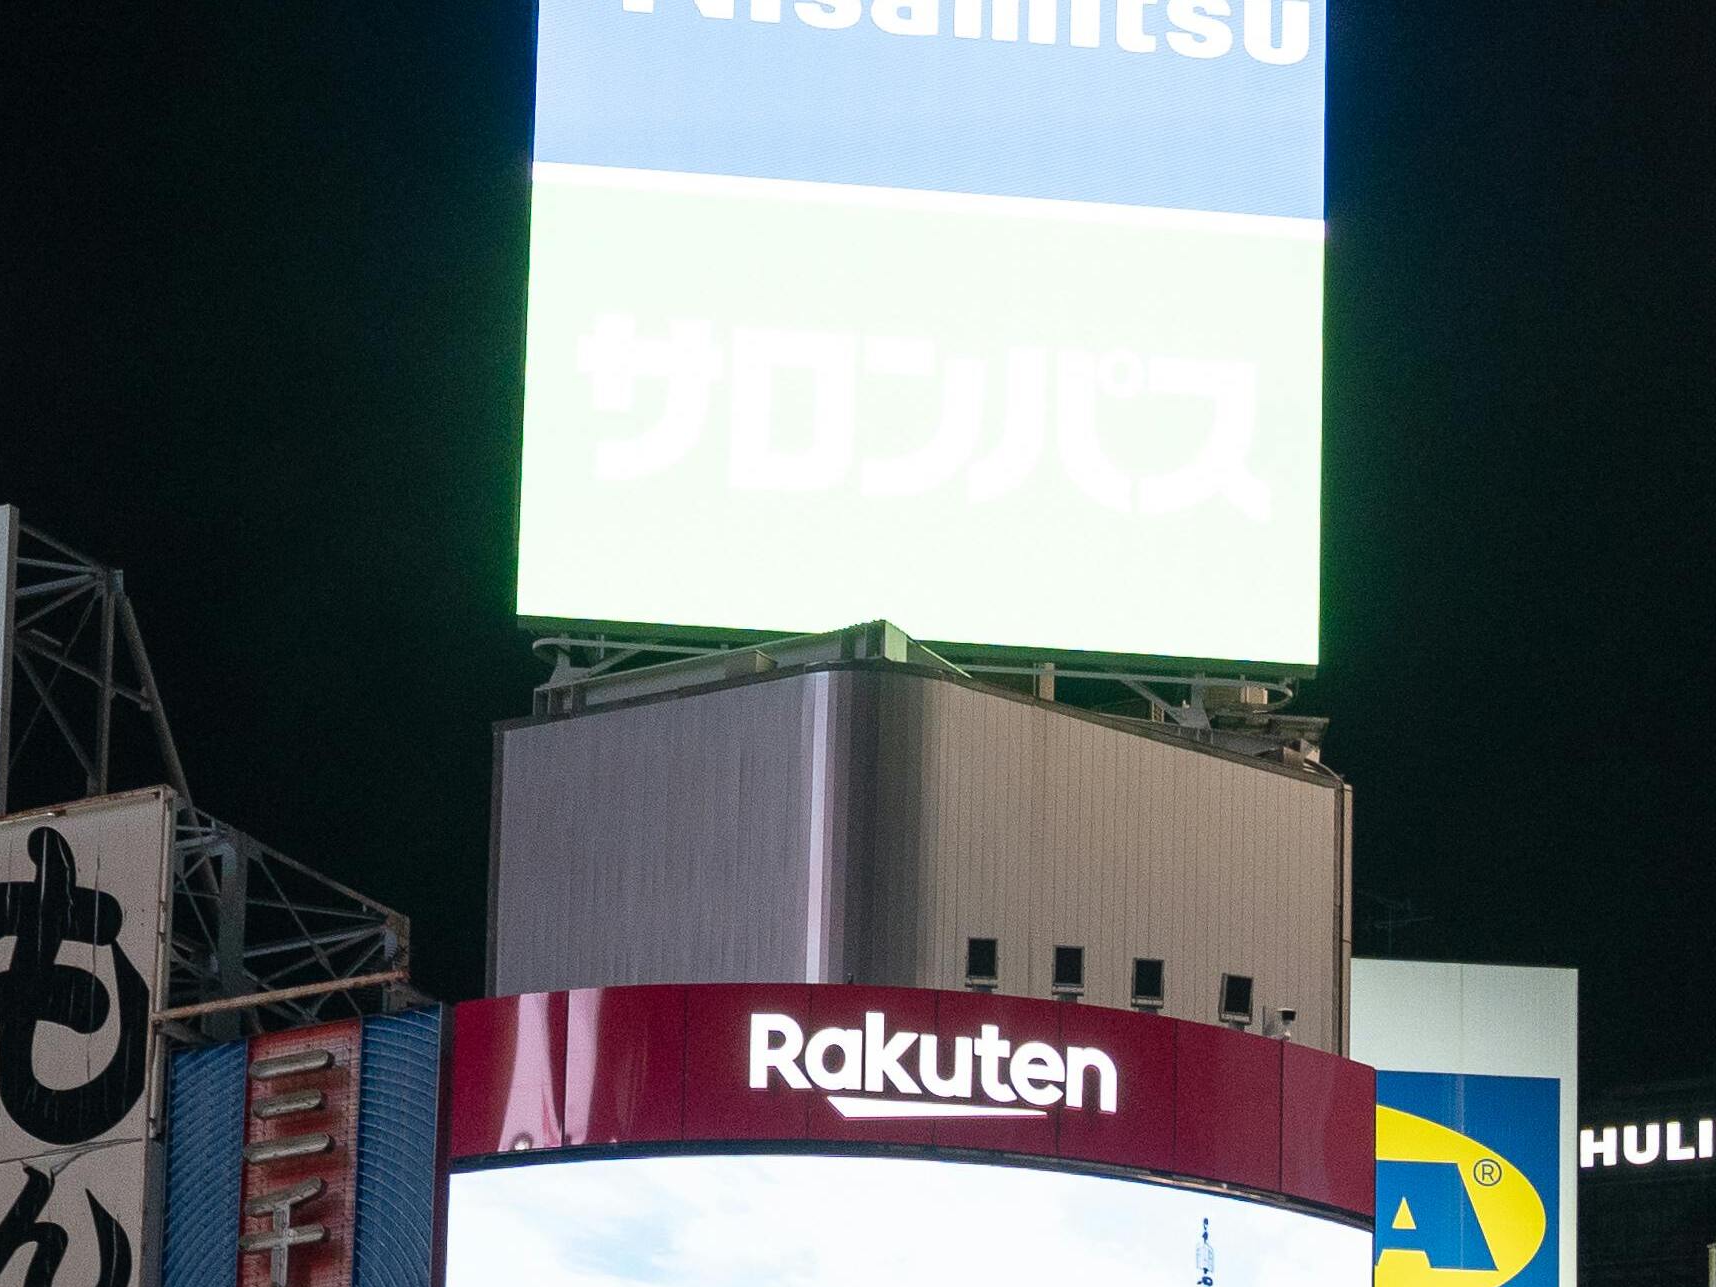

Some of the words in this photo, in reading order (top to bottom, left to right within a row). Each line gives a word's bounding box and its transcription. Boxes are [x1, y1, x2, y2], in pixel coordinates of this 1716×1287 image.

[577, 313, 1272, 521] サロンパス
[749, 1012, 1118, 1114] Rakuten
